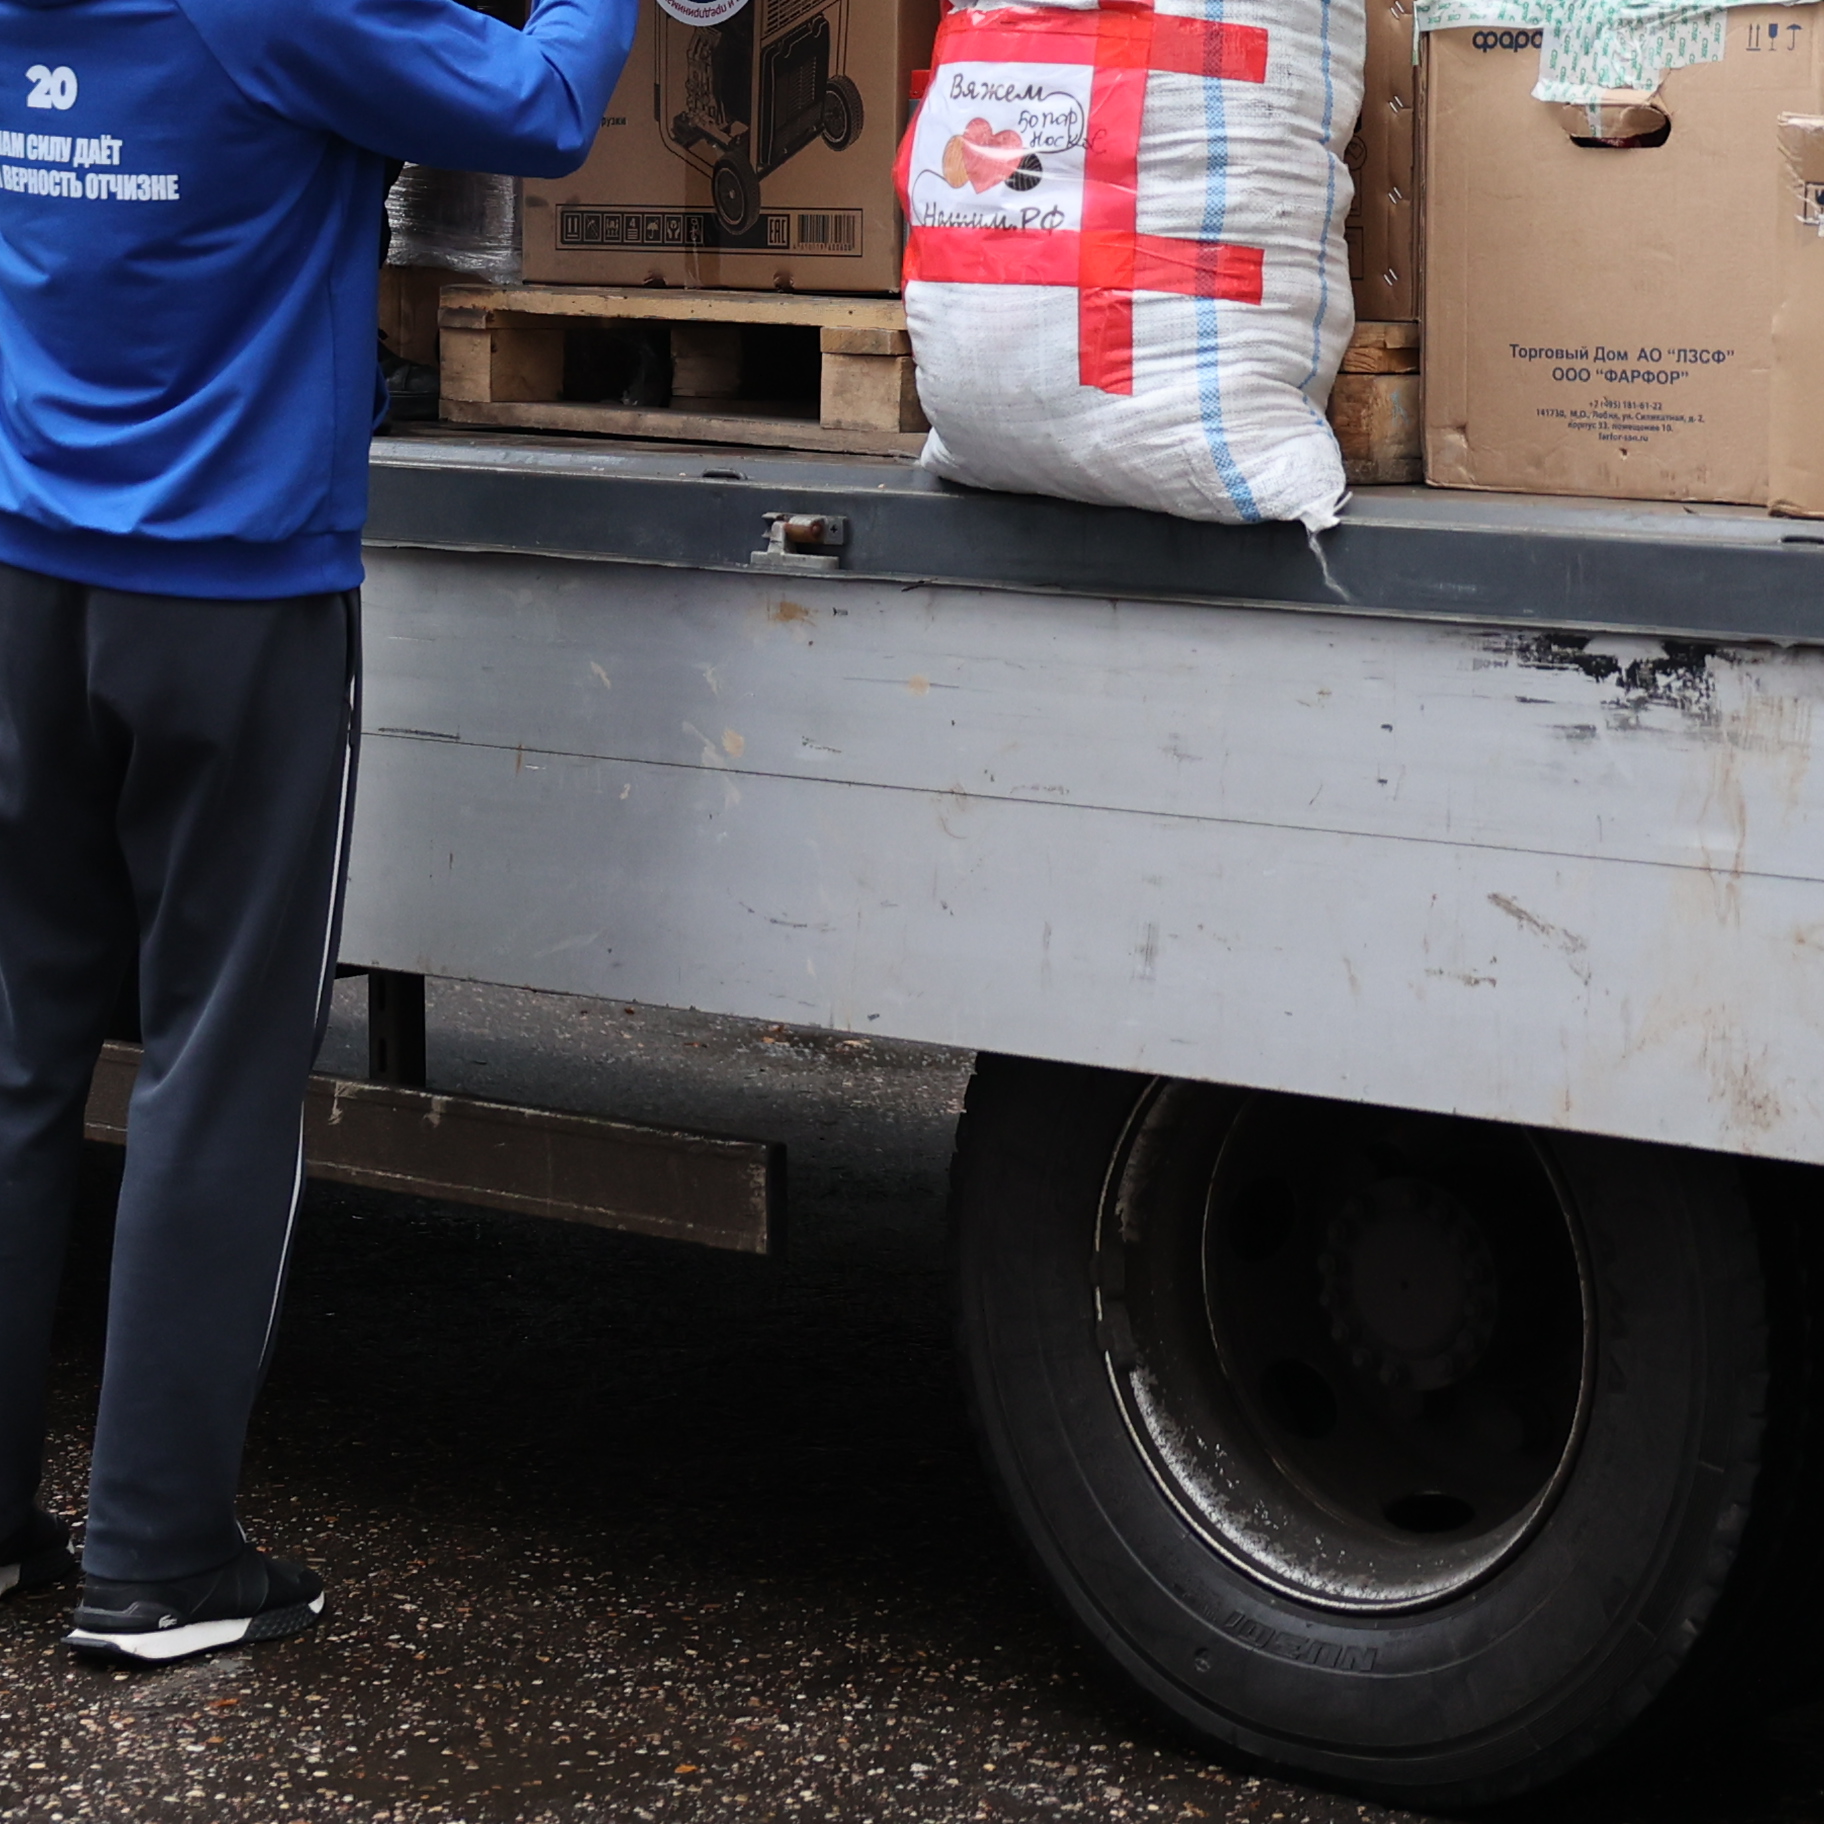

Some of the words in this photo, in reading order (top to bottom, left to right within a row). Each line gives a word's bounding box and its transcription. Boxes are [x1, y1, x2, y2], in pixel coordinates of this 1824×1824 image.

[25, 64, 78, 111] 20
[949, 72, 1046, 103] Вяжем
[26, 133, 72, 163] СИЛУ
[73, 134, 123, 168] ДАЁТ
[2, 164, 83, 199] ВЕРНОСТЬ
[85, 173, 180, 201] ОТЧИЗНЕ
[1509, 344, 1589, 362] Торговый
[1594, 347, 1629, 363] Дом
[1637, 348, 1662, 363] АО
[1552, 367, 1591, 382] ООО
